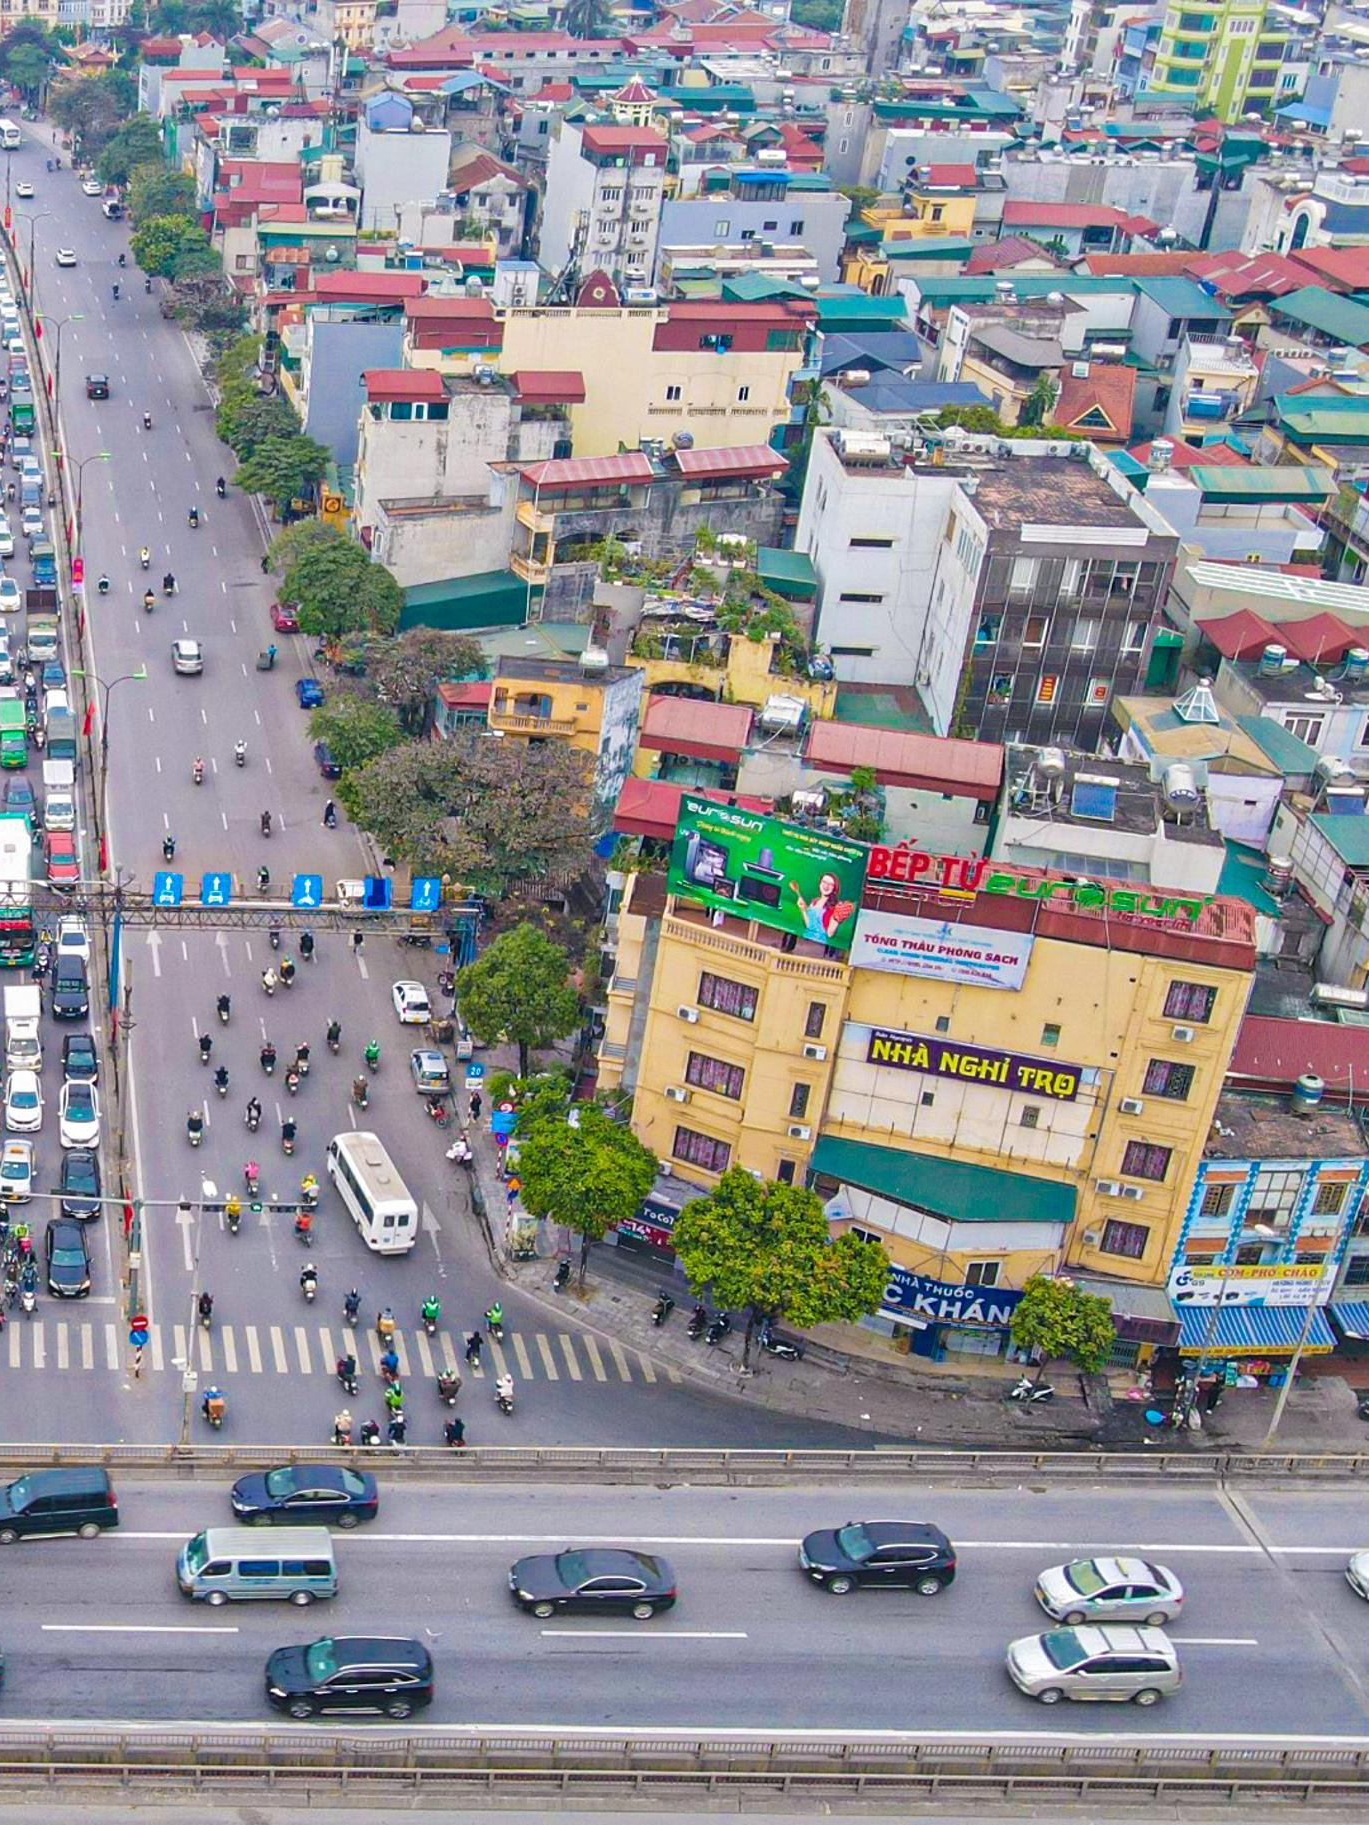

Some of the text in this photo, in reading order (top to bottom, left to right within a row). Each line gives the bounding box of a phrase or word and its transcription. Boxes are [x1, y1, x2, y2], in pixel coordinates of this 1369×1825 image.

[869, 839, 930, 881] BẾP
[940, 851, 991, 891] TỪ
[985, 871, 1208, 922] eurosun
[871, 1039, 1076, 1099] NHÀ NGHỈ TRỌ
[892, 1272, 975, 1299] NHÀ THUỐC
[914, 1293, 1016, 1325] KHÁN
